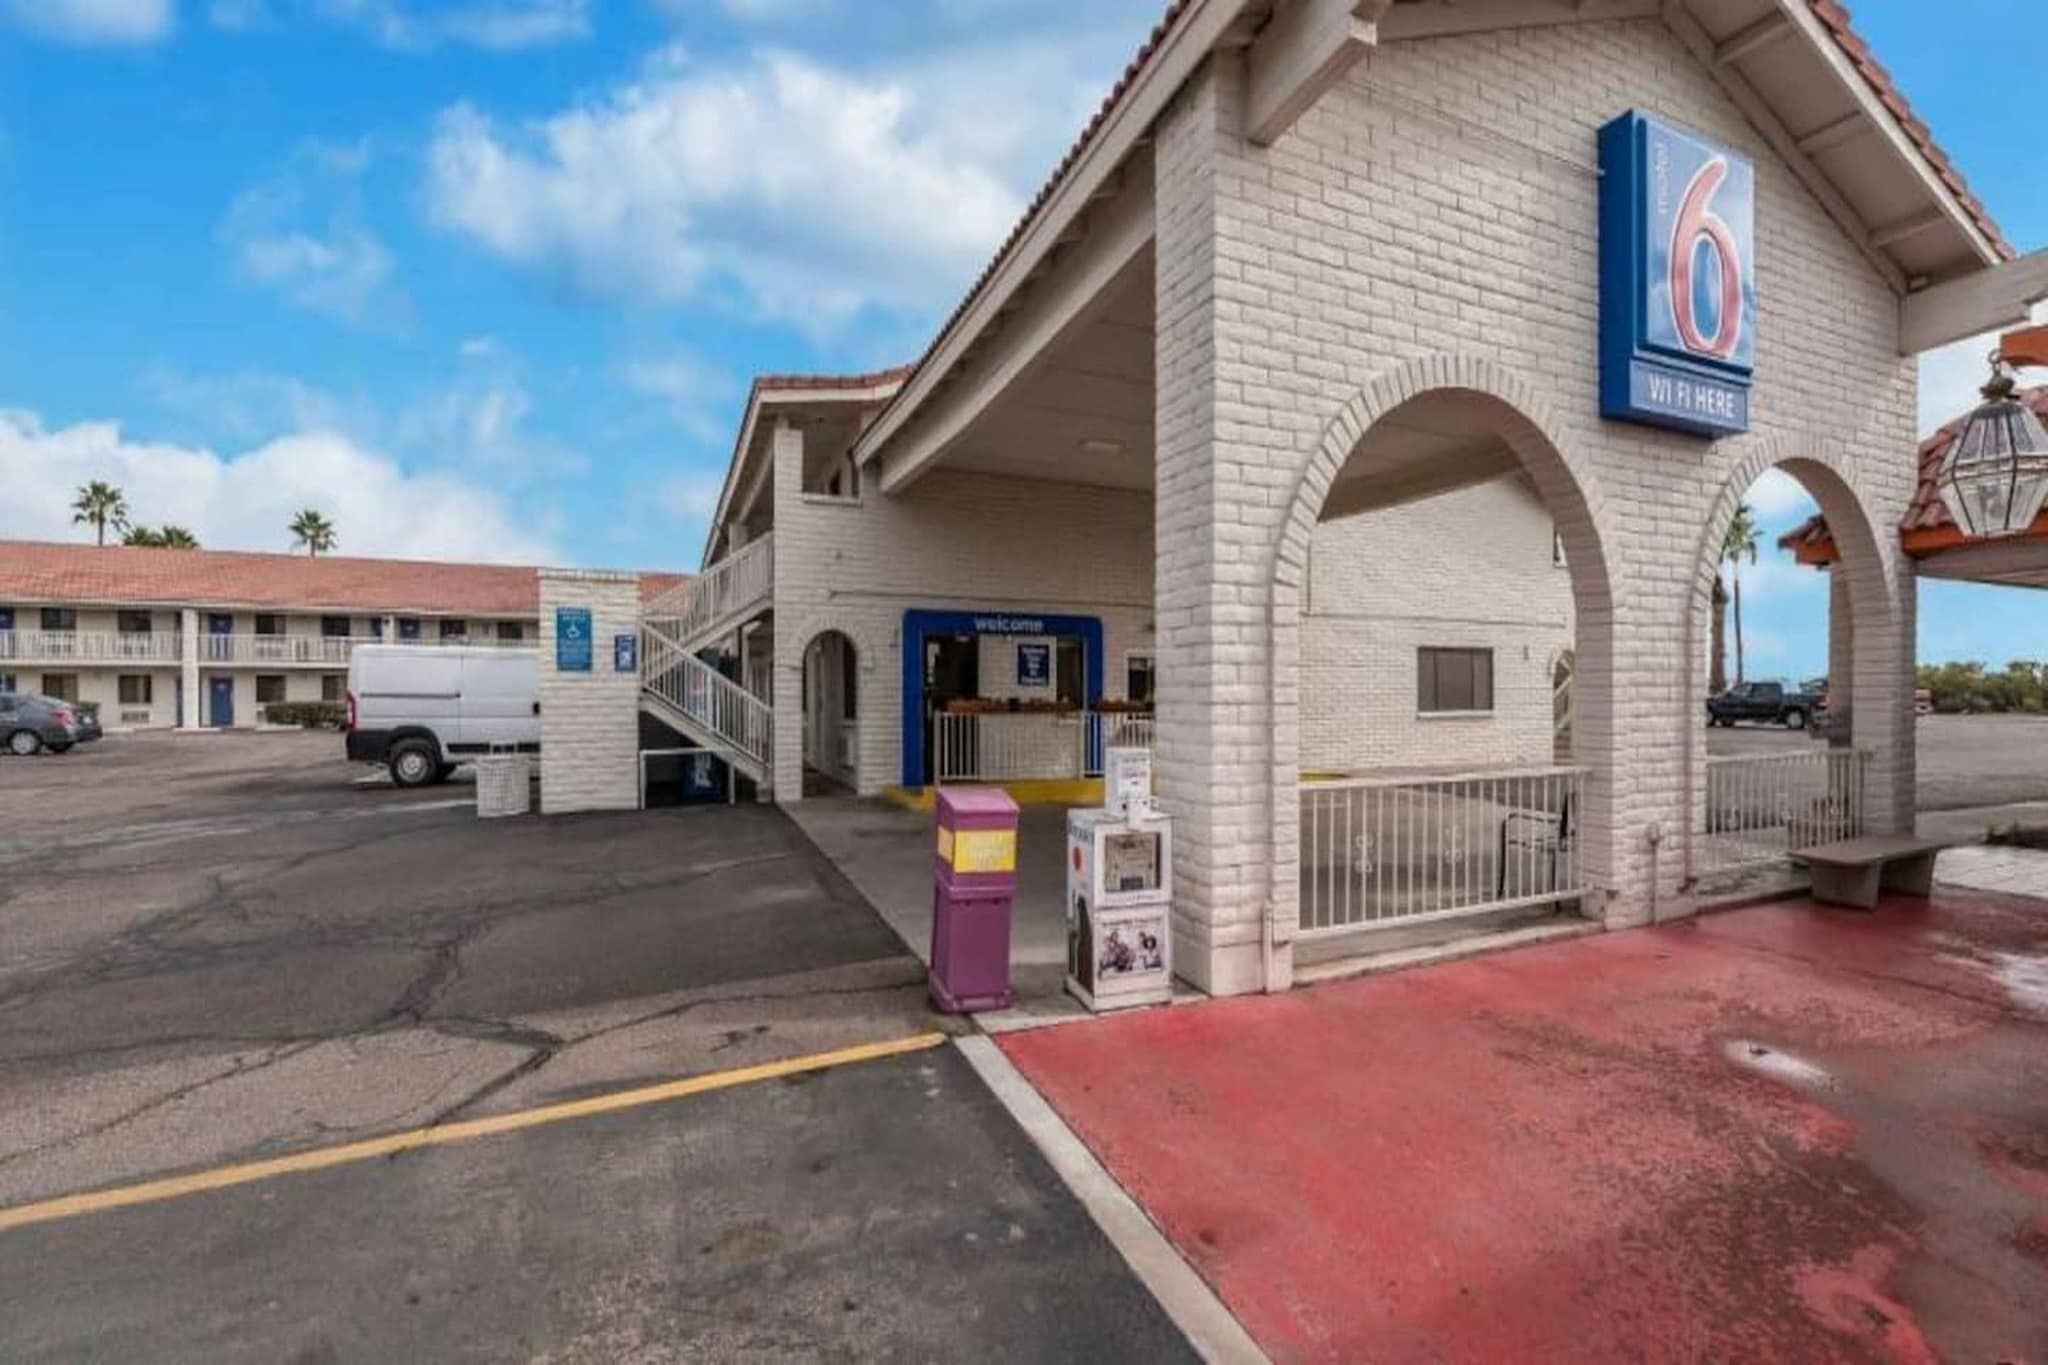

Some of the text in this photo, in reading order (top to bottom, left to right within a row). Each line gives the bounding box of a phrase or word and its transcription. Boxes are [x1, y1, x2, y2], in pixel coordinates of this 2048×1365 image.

[1668, 155, 1742, 358] 6
[1649, 373, 1734, 418] WI FI HERE
